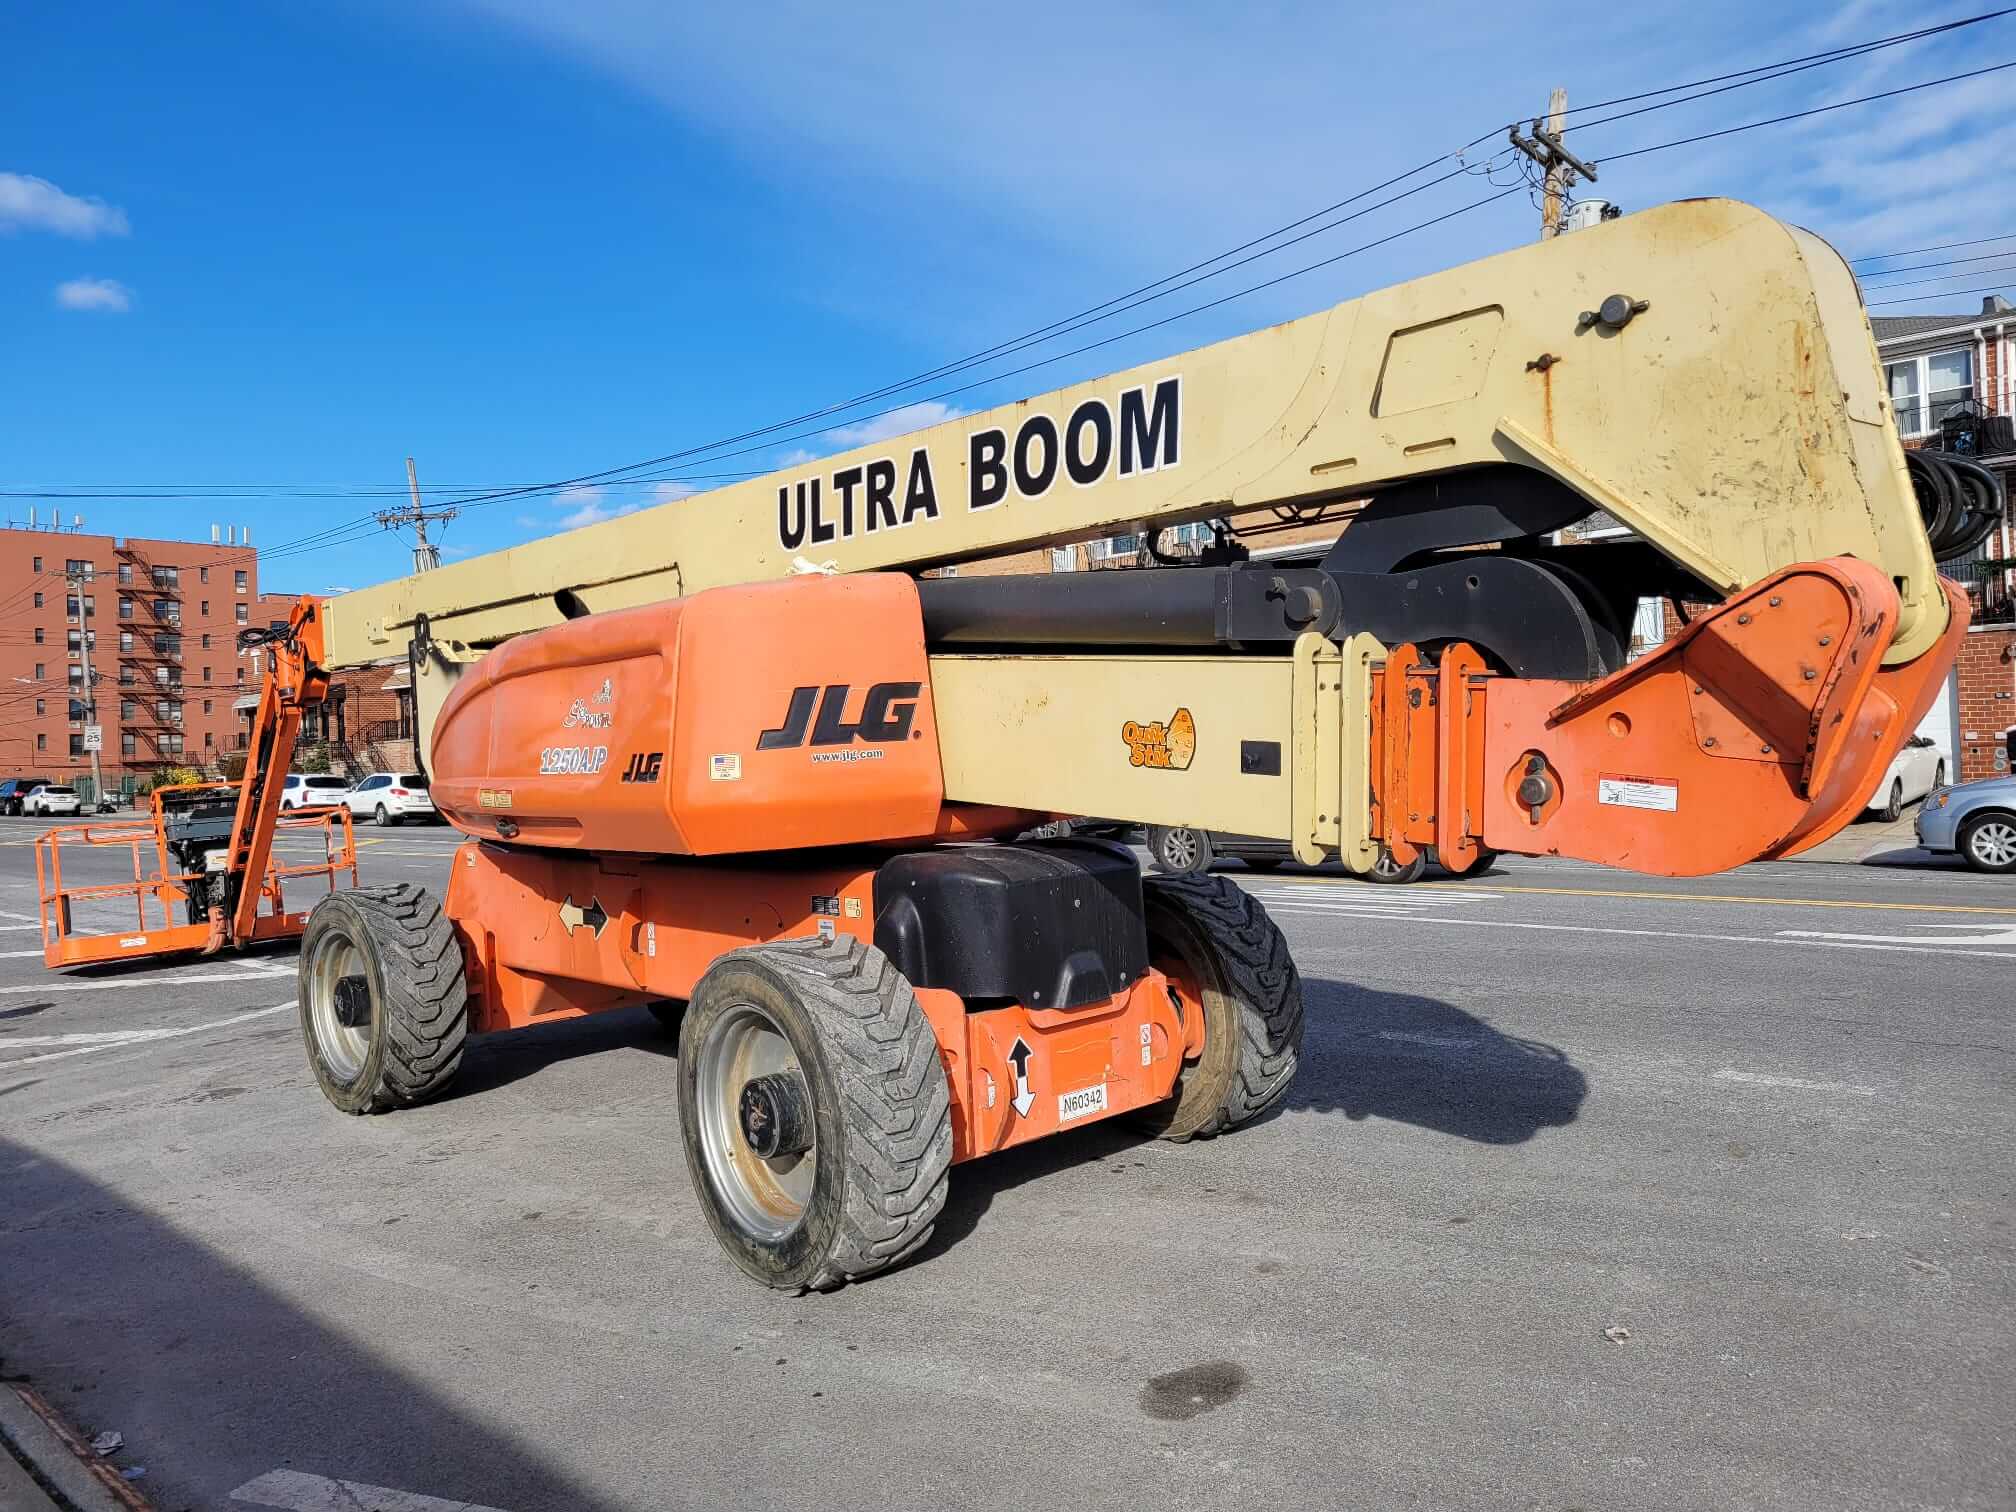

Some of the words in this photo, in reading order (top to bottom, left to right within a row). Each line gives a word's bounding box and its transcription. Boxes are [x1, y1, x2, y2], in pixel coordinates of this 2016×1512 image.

[779, 447, 939, 551] ULTRA
[968, 375, 1182, 512] BOOM
[756, 682, 922, 750] JLG
[87, 734, 100, 742] 25
[539, 746, 608, 775] 1250AJP
[621, 752, 664, 783] JLG
[811, 749, 883, 764] www.jlg.com
[1064, 1088, 1102, 1113] N60342
